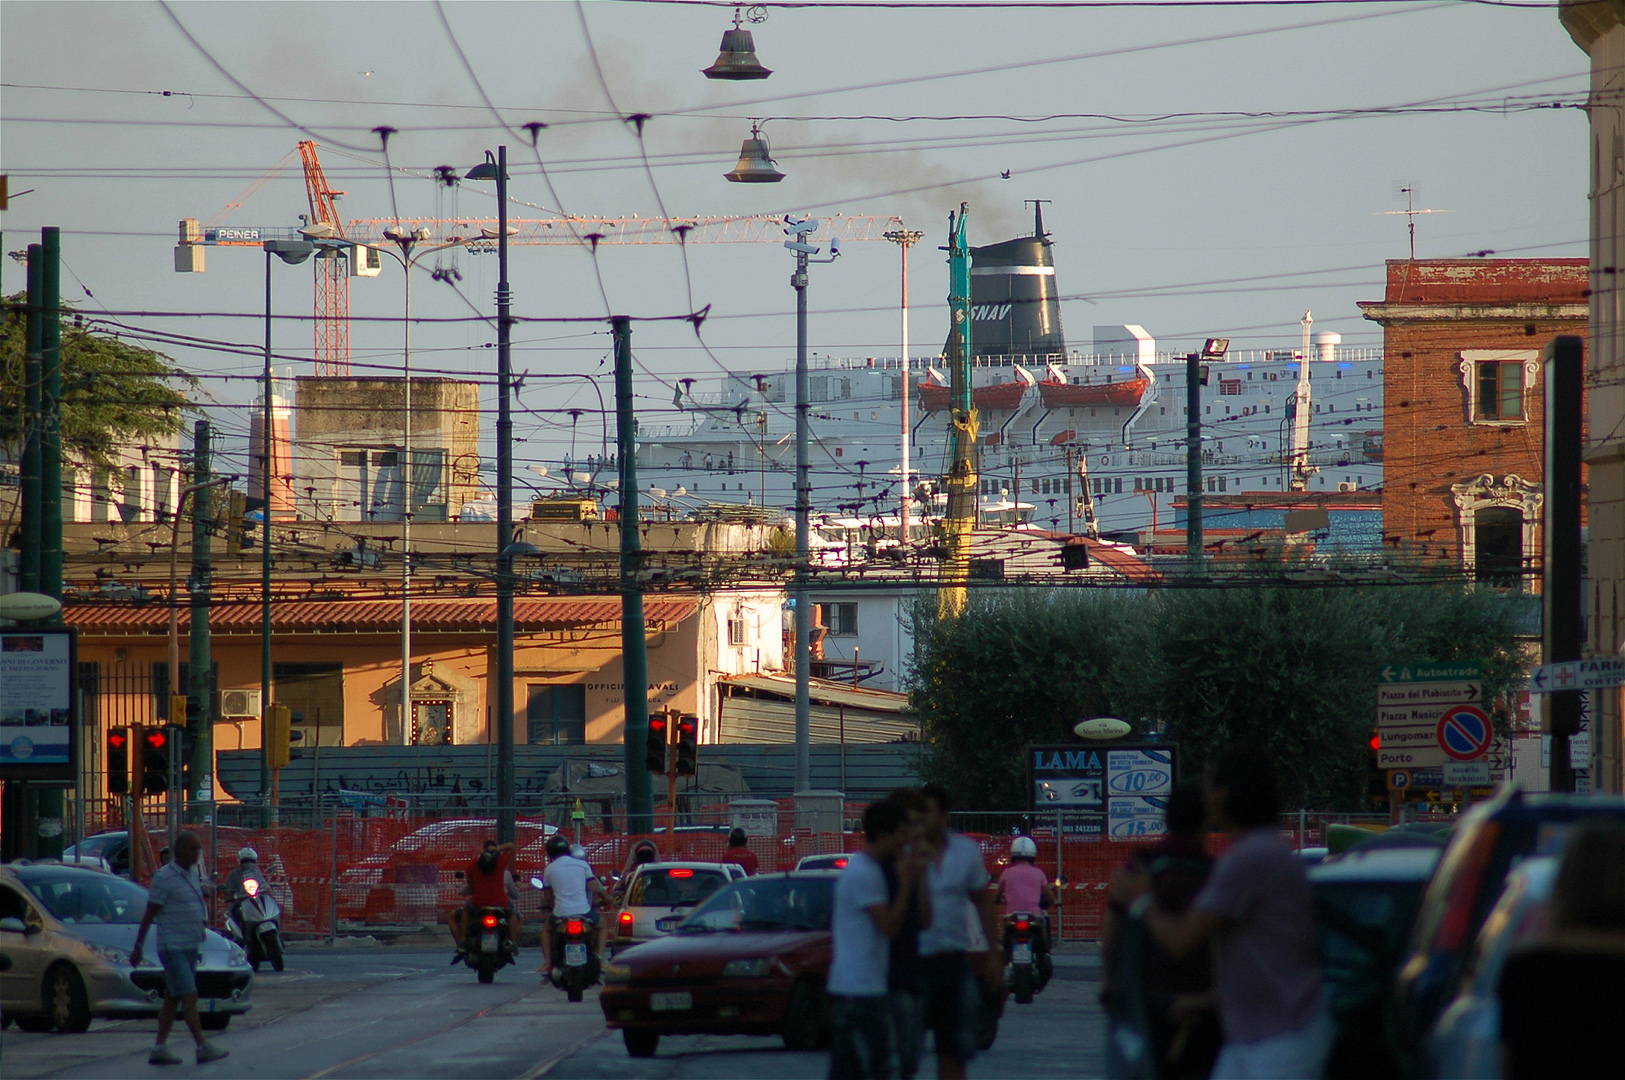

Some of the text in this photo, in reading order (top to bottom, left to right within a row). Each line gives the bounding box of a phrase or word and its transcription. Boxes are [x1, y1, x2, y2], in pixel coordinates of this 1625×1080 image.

[971, 305, 1012, 321] SNAV
[1416, 667, 1479, 678] Autostrade
[587, 683, 624, 691] OFFICI
[1381, 687, 1462, 699] Piazza del Plebiscito
[1381, 711, 1407, 720] Piazza
[1381, 732, 1436, 742] Lungomar
[1034, 751, 1103, 770] LAMA
[1381, 753, 1413, 763] Porto
[1412, 772, 1443, 780] Parkin
